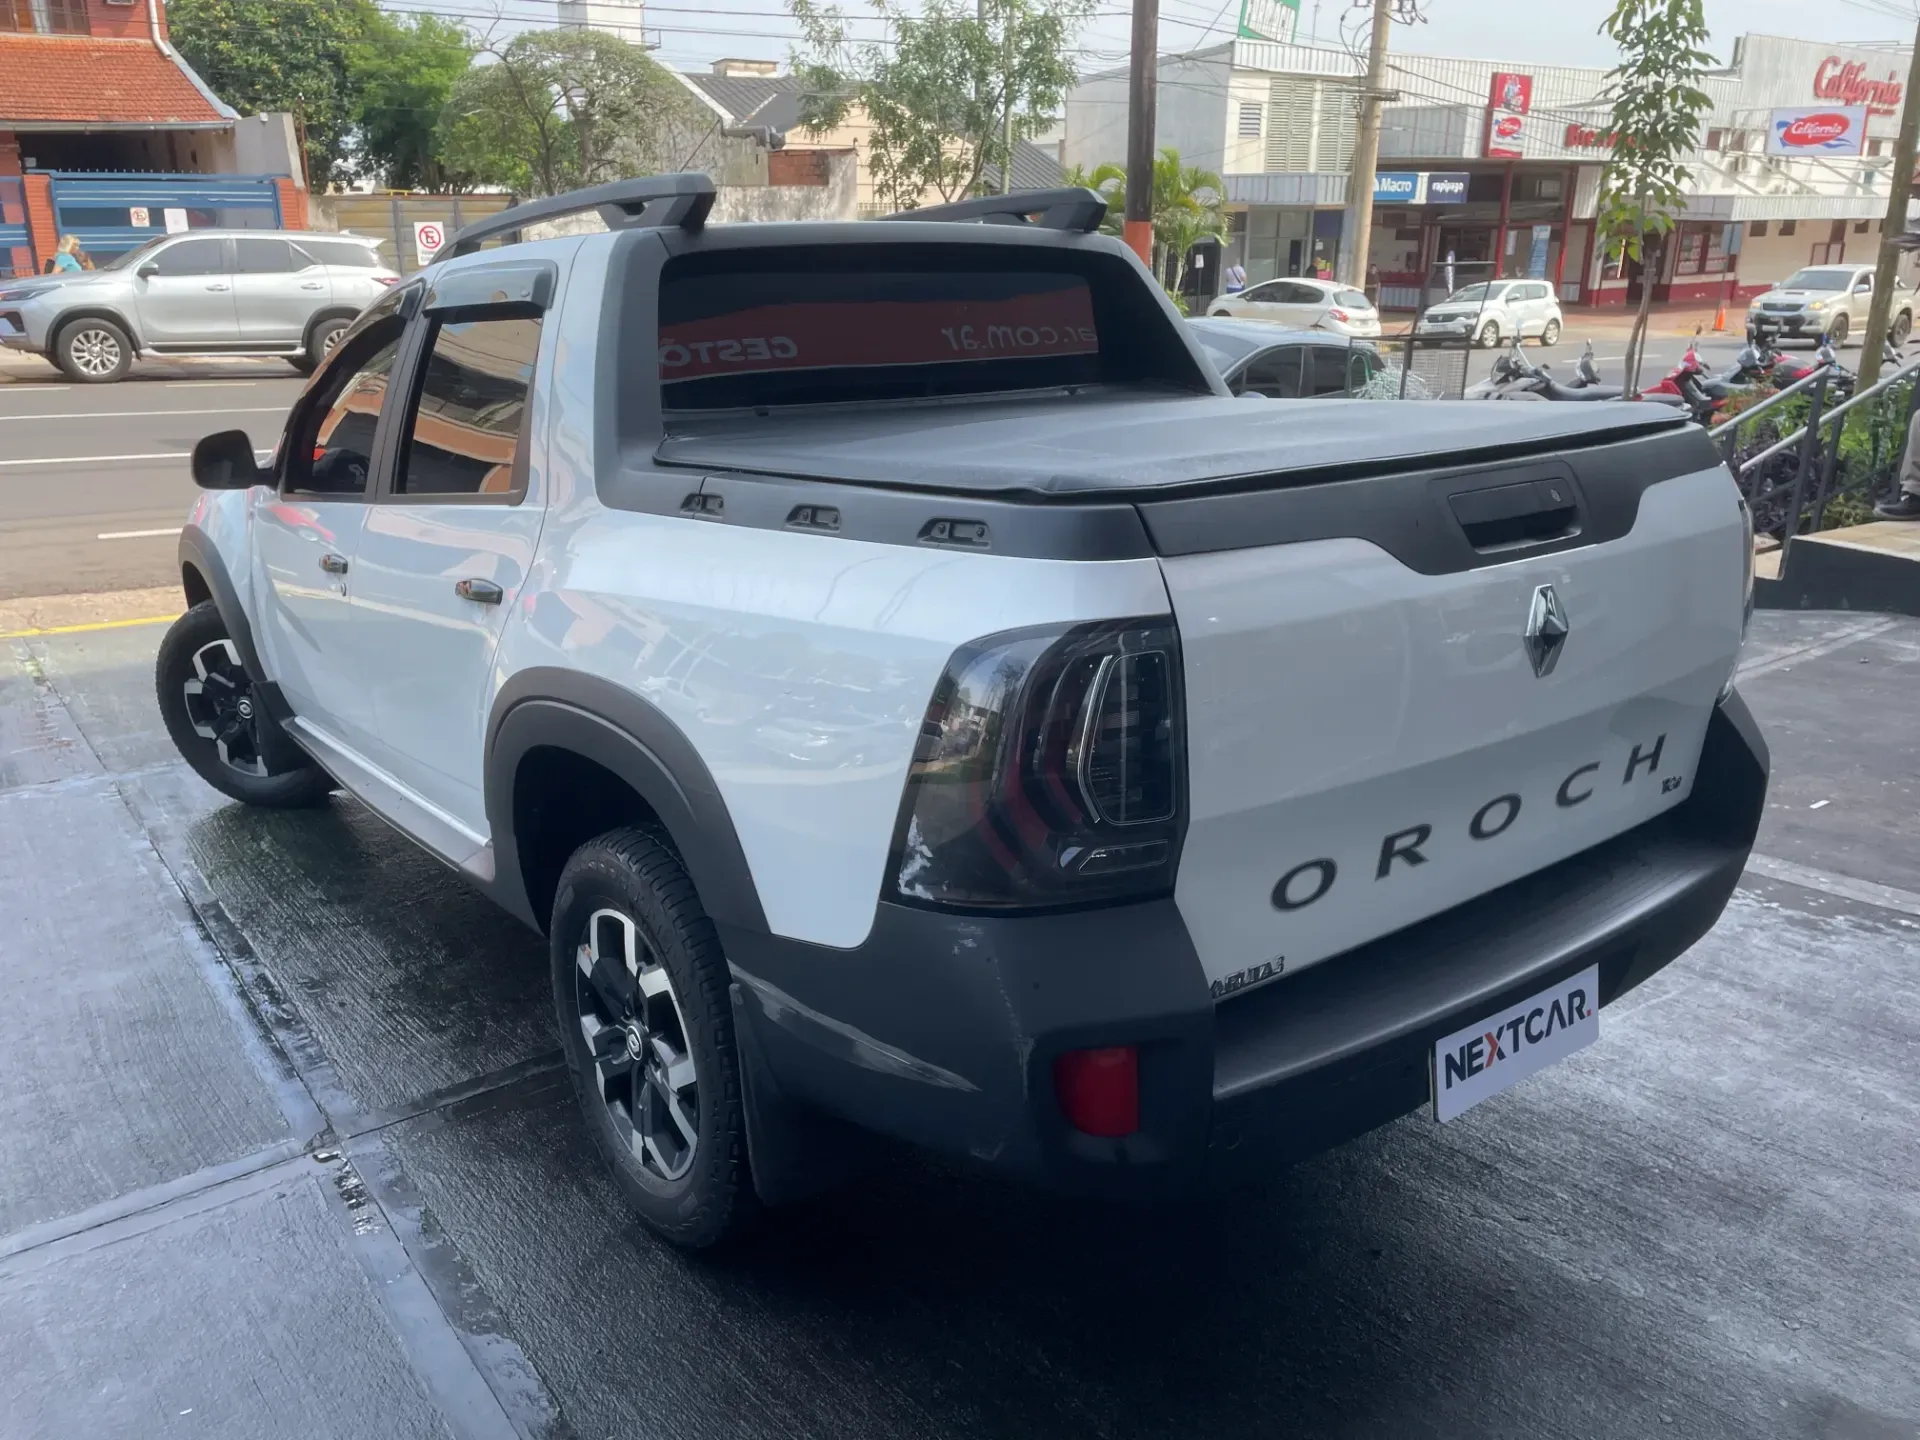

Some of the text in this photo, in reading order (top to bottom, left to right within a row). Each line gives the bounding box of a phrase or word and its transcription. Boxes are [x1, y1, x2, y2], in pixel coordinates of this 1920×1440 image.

[1814, 56, 1902, 106] California
[1791, 121, 1842, 139] California
[1381, 178, 1412, 192] Macro
[1431, 180, 1464, 193] rapipago
[1270, 733, 1667, 911] OROCH
